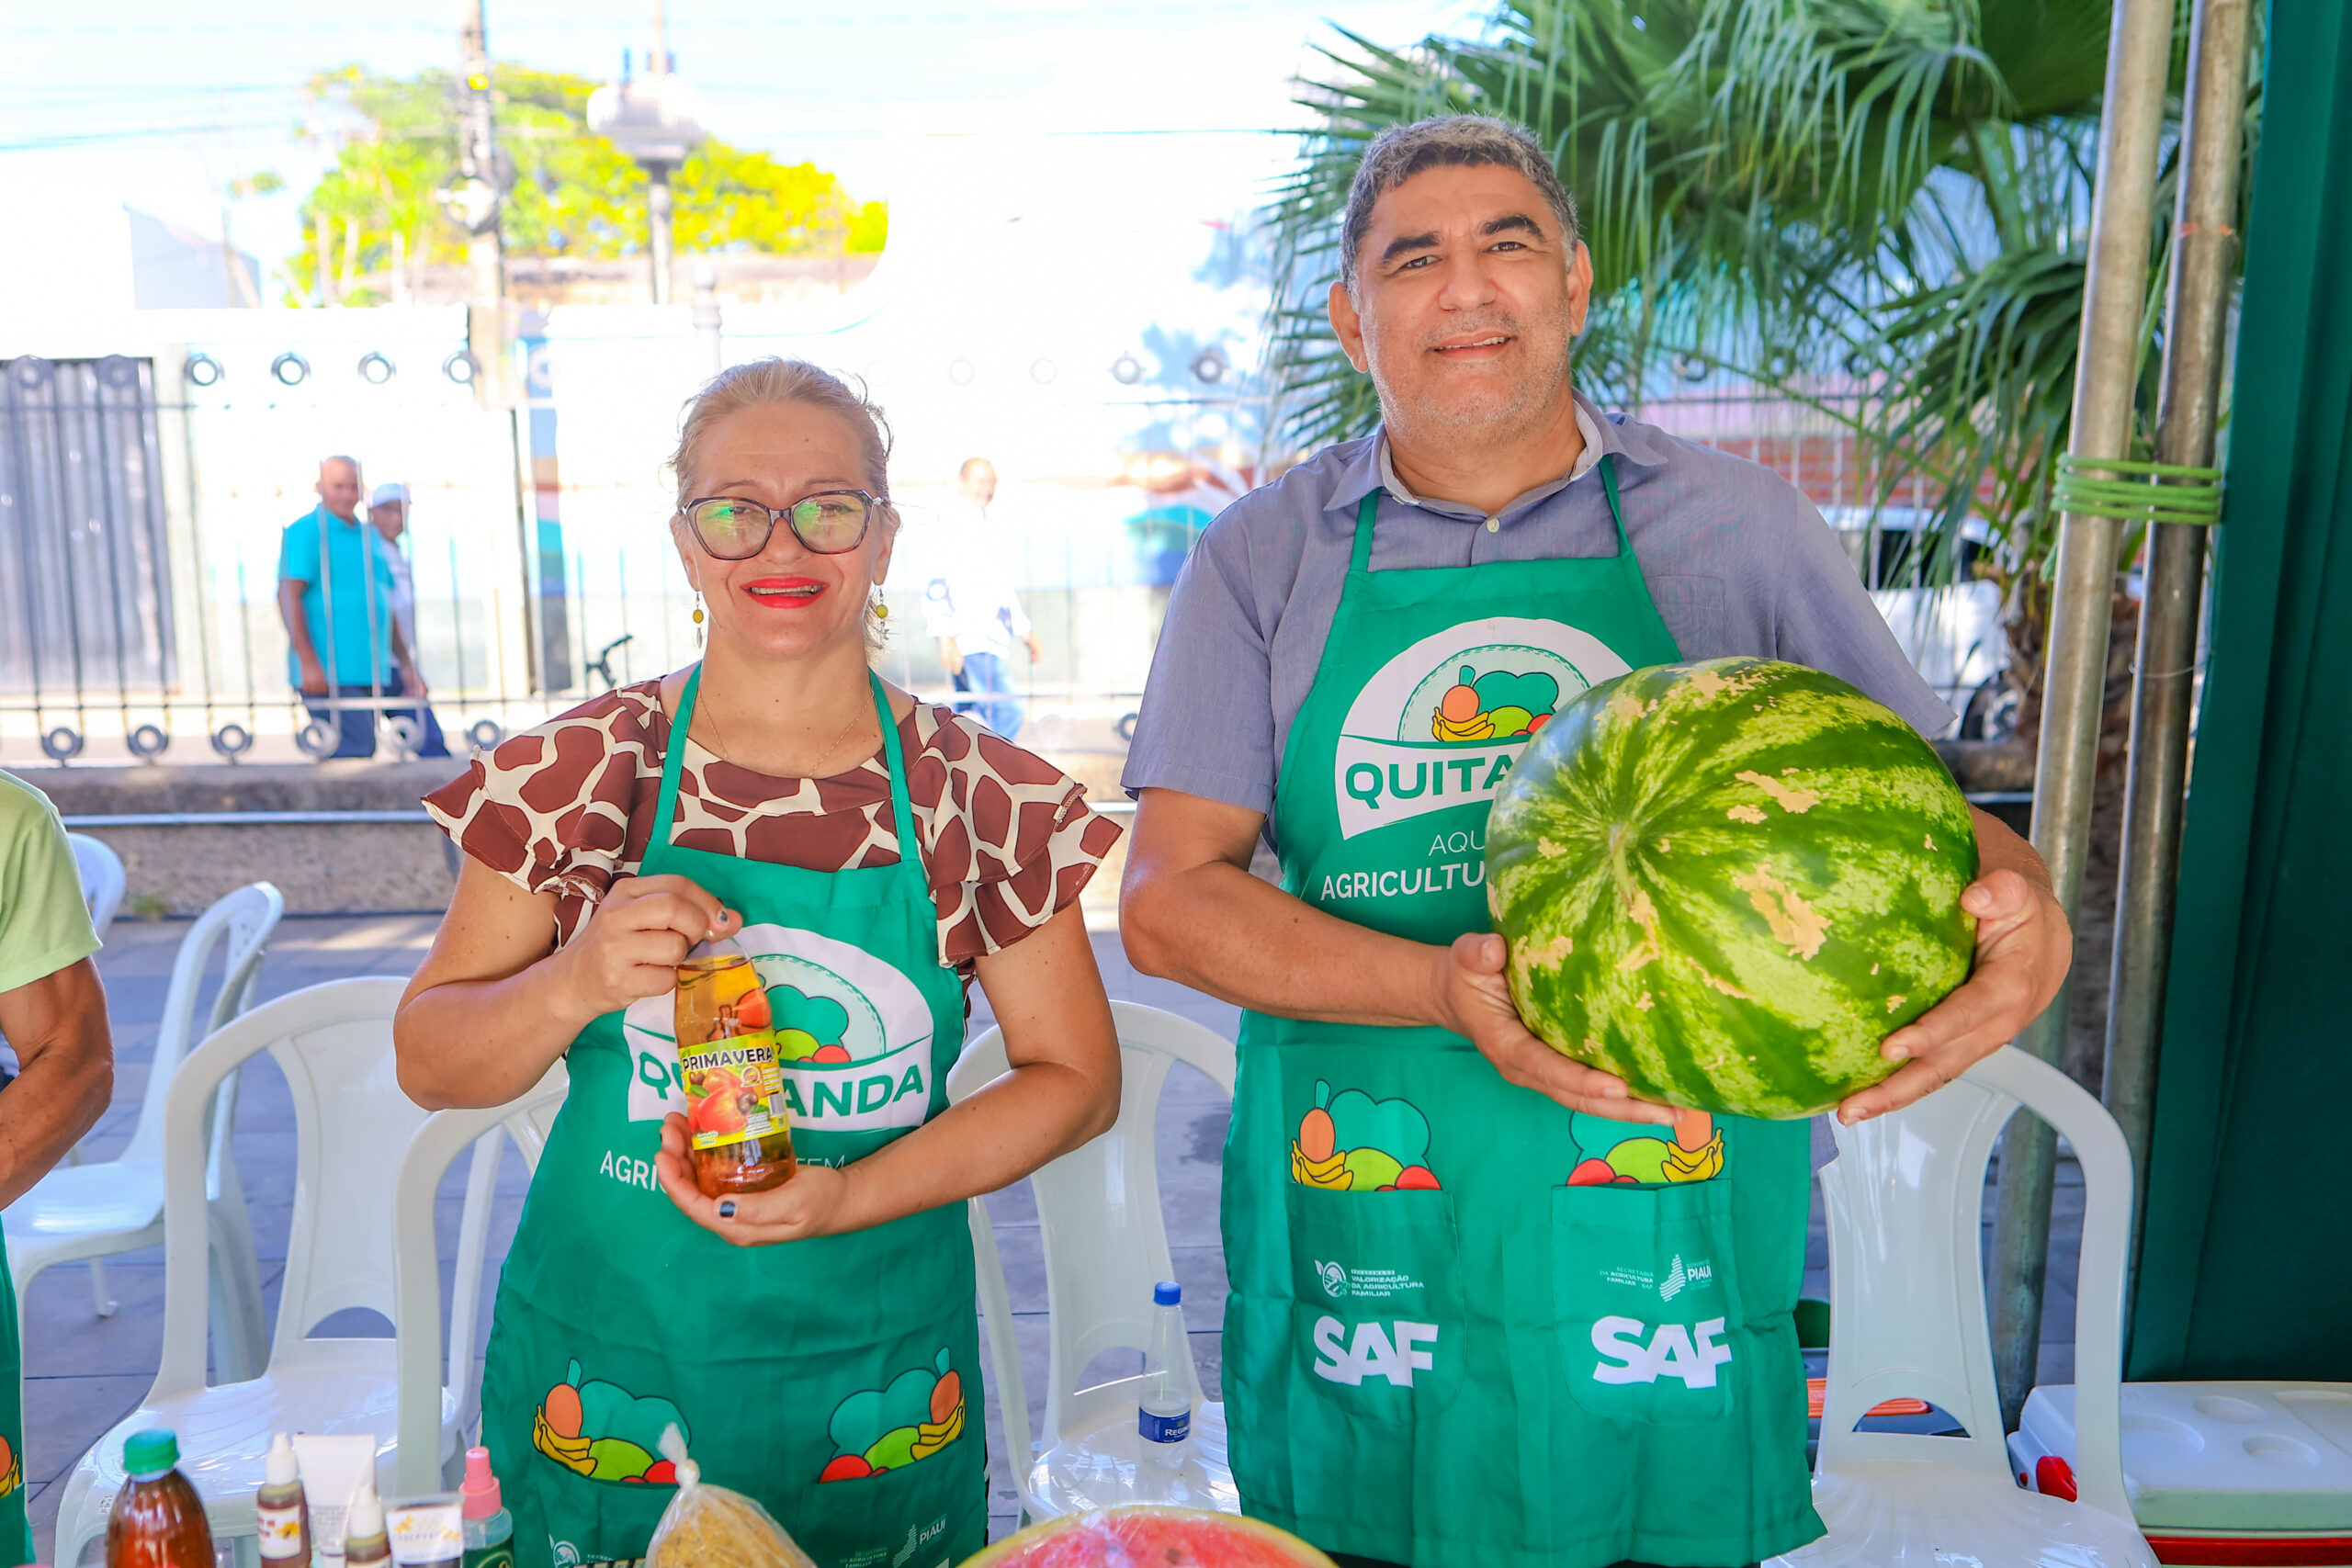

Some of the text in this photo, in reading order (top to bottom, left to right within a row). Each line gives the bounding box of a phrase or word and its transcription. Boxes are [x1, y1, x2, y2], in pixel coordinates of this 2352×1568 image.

[1345, 754, 1514, 809] QUITA
[1428, 829, 1485, 856] AQU
[1320, 860, 1485, 901] AGRICULTU
[683, 1046, 774, 1072] PRIMAVERA
[639, 1051, 923, 1118] QANDA
[599, 1149, 666, 1194] AGRI
[1351, 1274, 1409, 1283] VALORIZAÇÃO
[1363, 1281, 1425, 1291] AGRICULTURA
[1313, 1314, 1439, 1388] SAF
[1590, 1315, 1732, 1389] SAF
